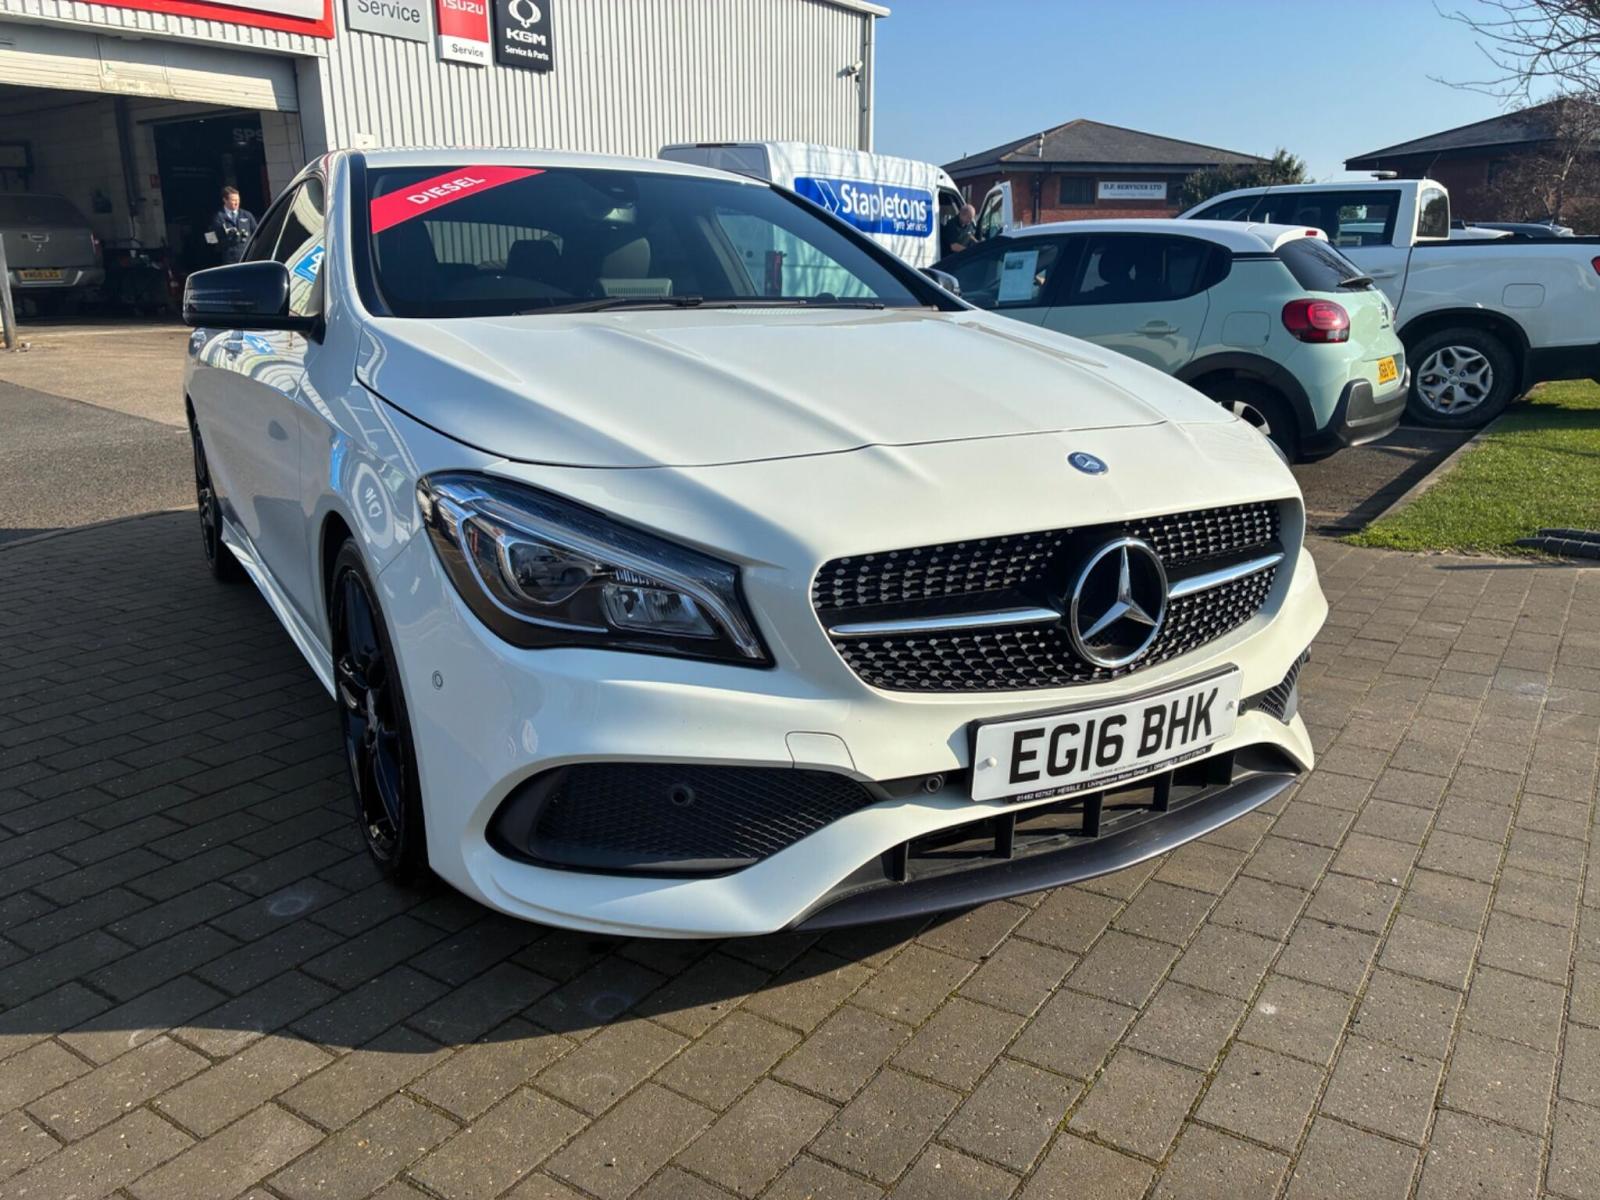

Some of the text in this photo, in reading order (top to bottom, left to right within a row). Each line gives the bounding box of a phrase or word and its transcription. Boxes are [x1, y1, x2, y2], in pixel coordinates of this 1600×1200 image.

[357, 0, 421, 24] Service
[506, 27, 547, 46] KGM
[452, 43, 484, 58] Service
[505, 45, 527, 57] Service
[533, 50, 550, 61] Parts
[407, 176, 486, 205] DIESEL
[840, 183, 928, 223] Stapletons
[1009, 687, 1219, 785] EG16 BHK
